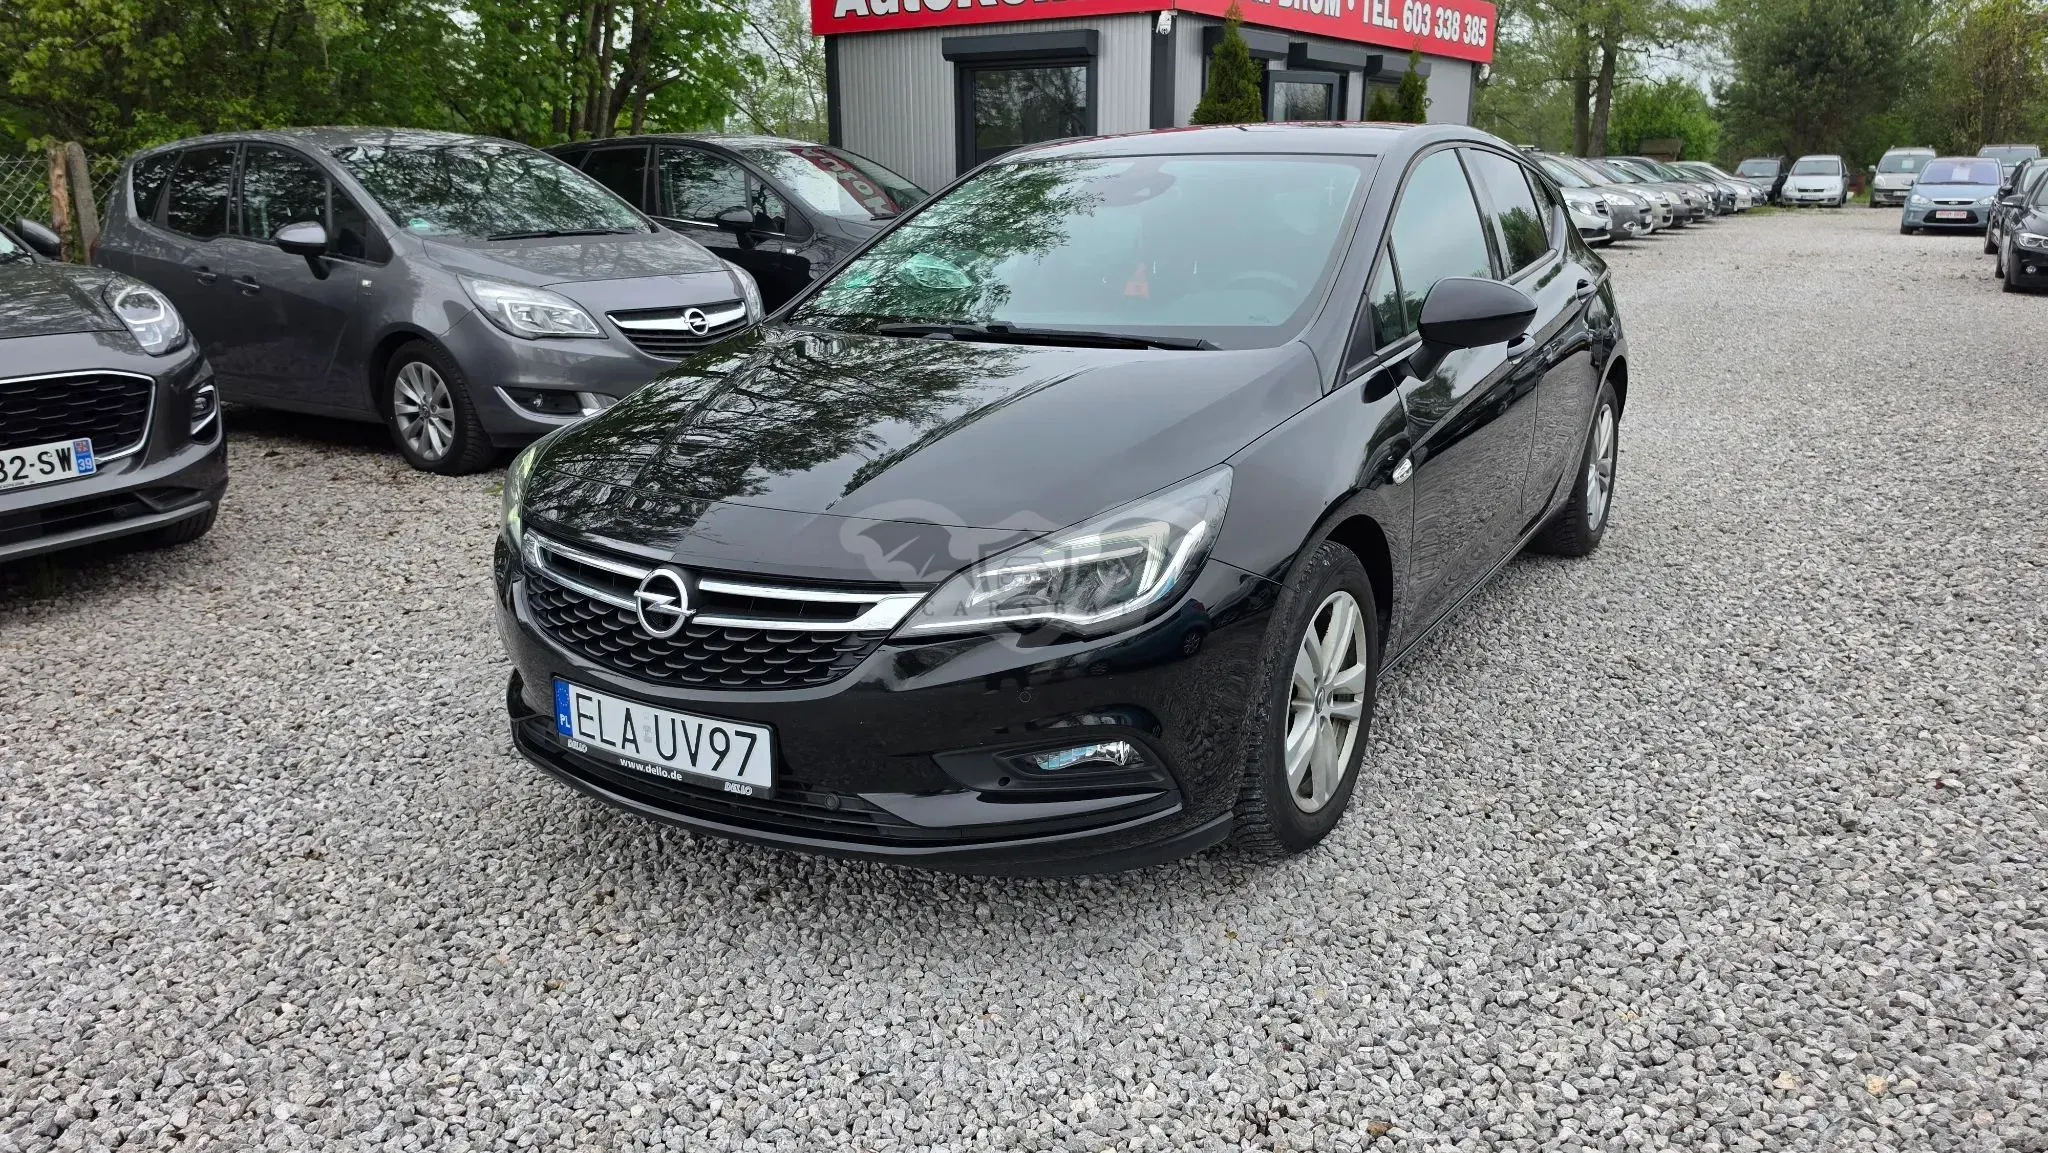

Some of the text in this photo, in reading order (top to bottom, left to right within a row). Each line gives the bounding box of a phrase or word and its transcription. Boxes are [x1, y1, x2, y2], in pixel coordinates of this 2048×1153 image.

[1362, 0, 1398, 29] TEL.
[1403, 0, 1431, 36] 603
[1435, 6, 1460, 42] 338
[1463, 14, 1487, 47] 385
[78, 457, 93, 471] 39
[559, 713, 571, 728] PL
[576, 692, 758, 777] ELA UV97
[620, 758, 683, 781] www.dello.de
